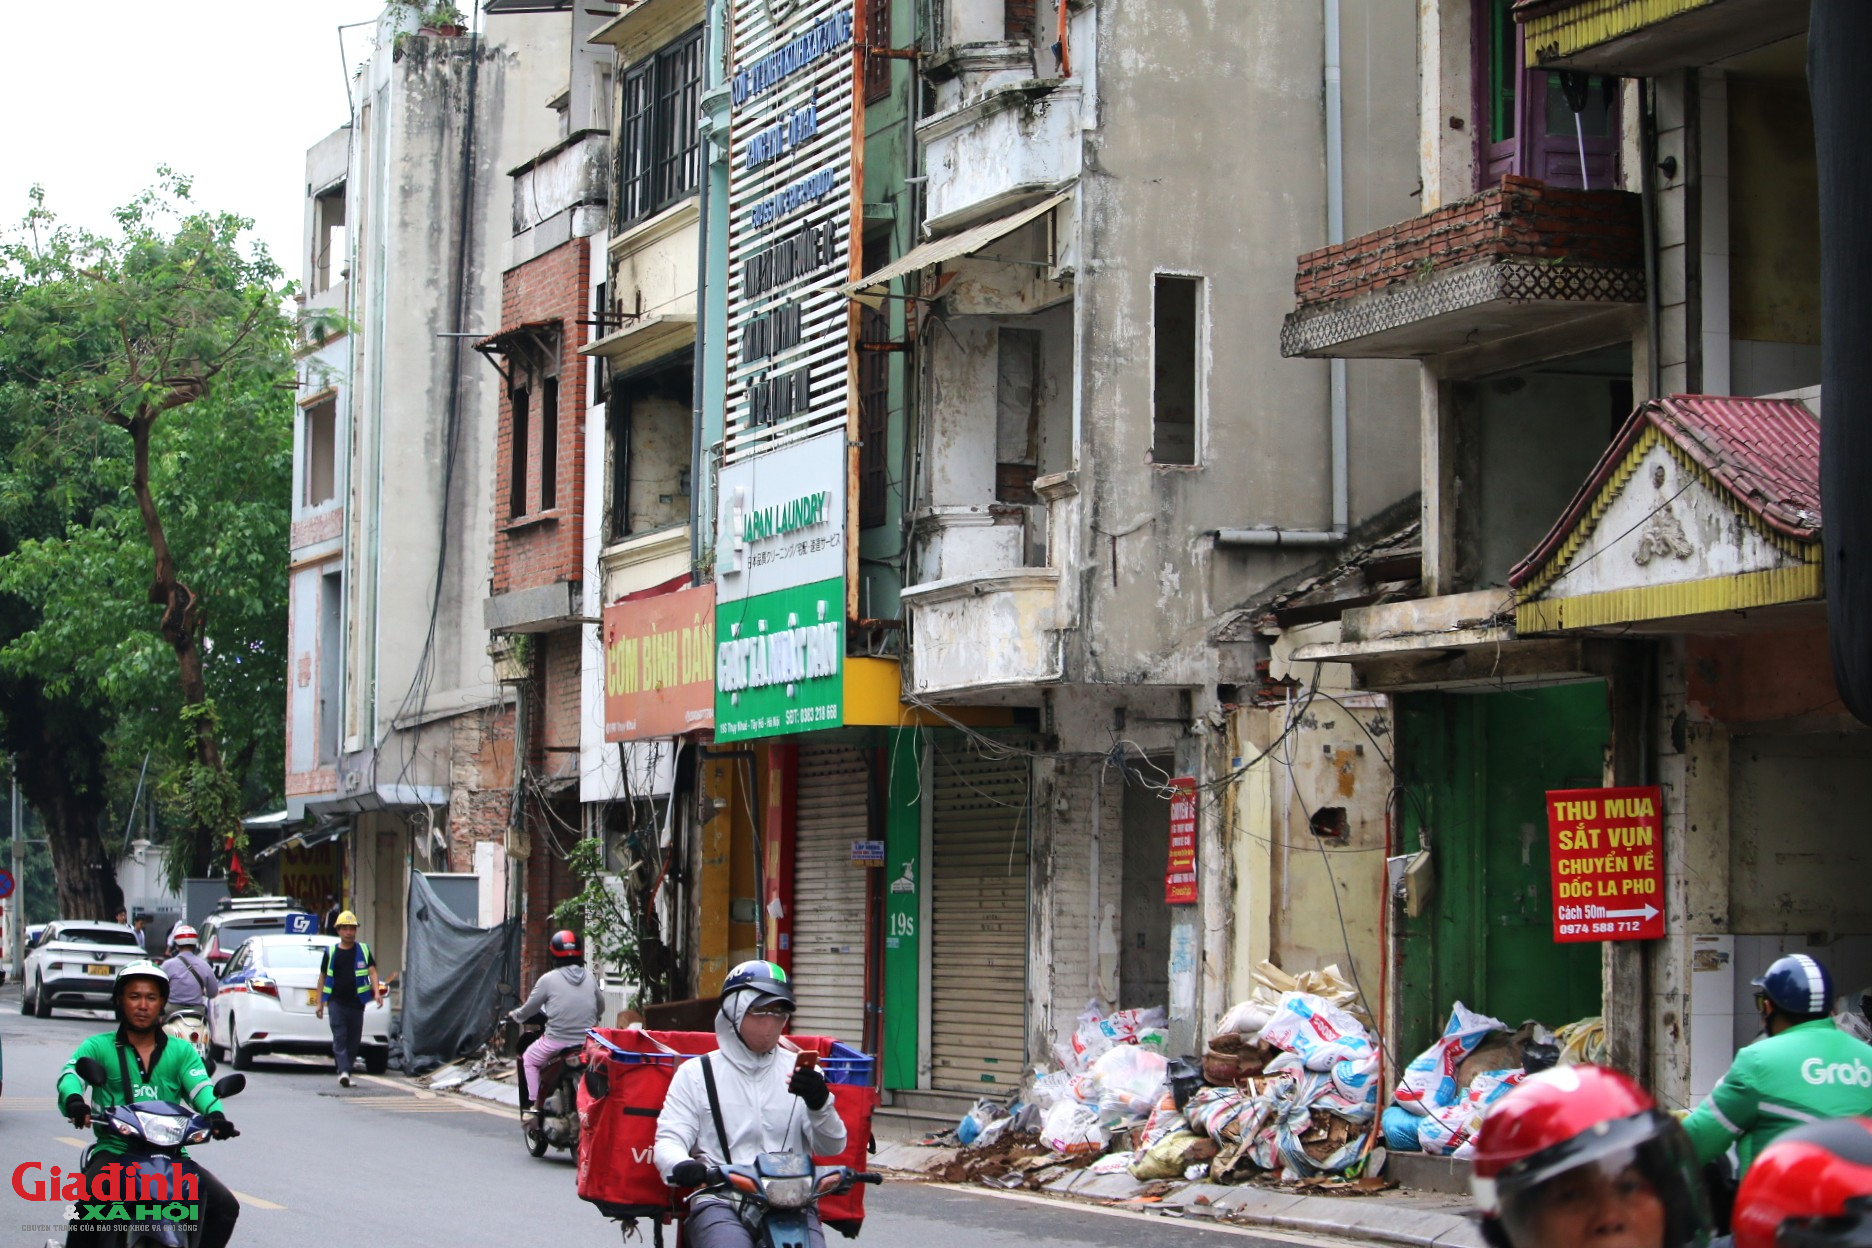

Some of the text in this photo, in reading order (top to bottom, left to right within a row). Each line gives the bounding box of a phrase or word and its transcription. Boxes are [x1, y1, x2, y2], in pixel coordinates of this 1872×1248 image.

[742, 491, 826, 543] JAPAN LAUNDRY
[642, 622, 678, 692] BÌNH
[682, 613, 713, 685] DÂN
[1554, 797, 1655, 821] THU MUA
[1559, 822, 1653, 852] SẮT VỤN
[1558, 849, 1655, 875] CHUYỂN VỀ
[1559, 876, 1656, 898] DỐC LA PHO
[1559, 904, 1607, 920] Cách 50m
[1559, 921, 1640, 935] 0974 588 712
[1801, 1057, 1872, 1089] Grab
[631, 1145, 655, 1165] vi
